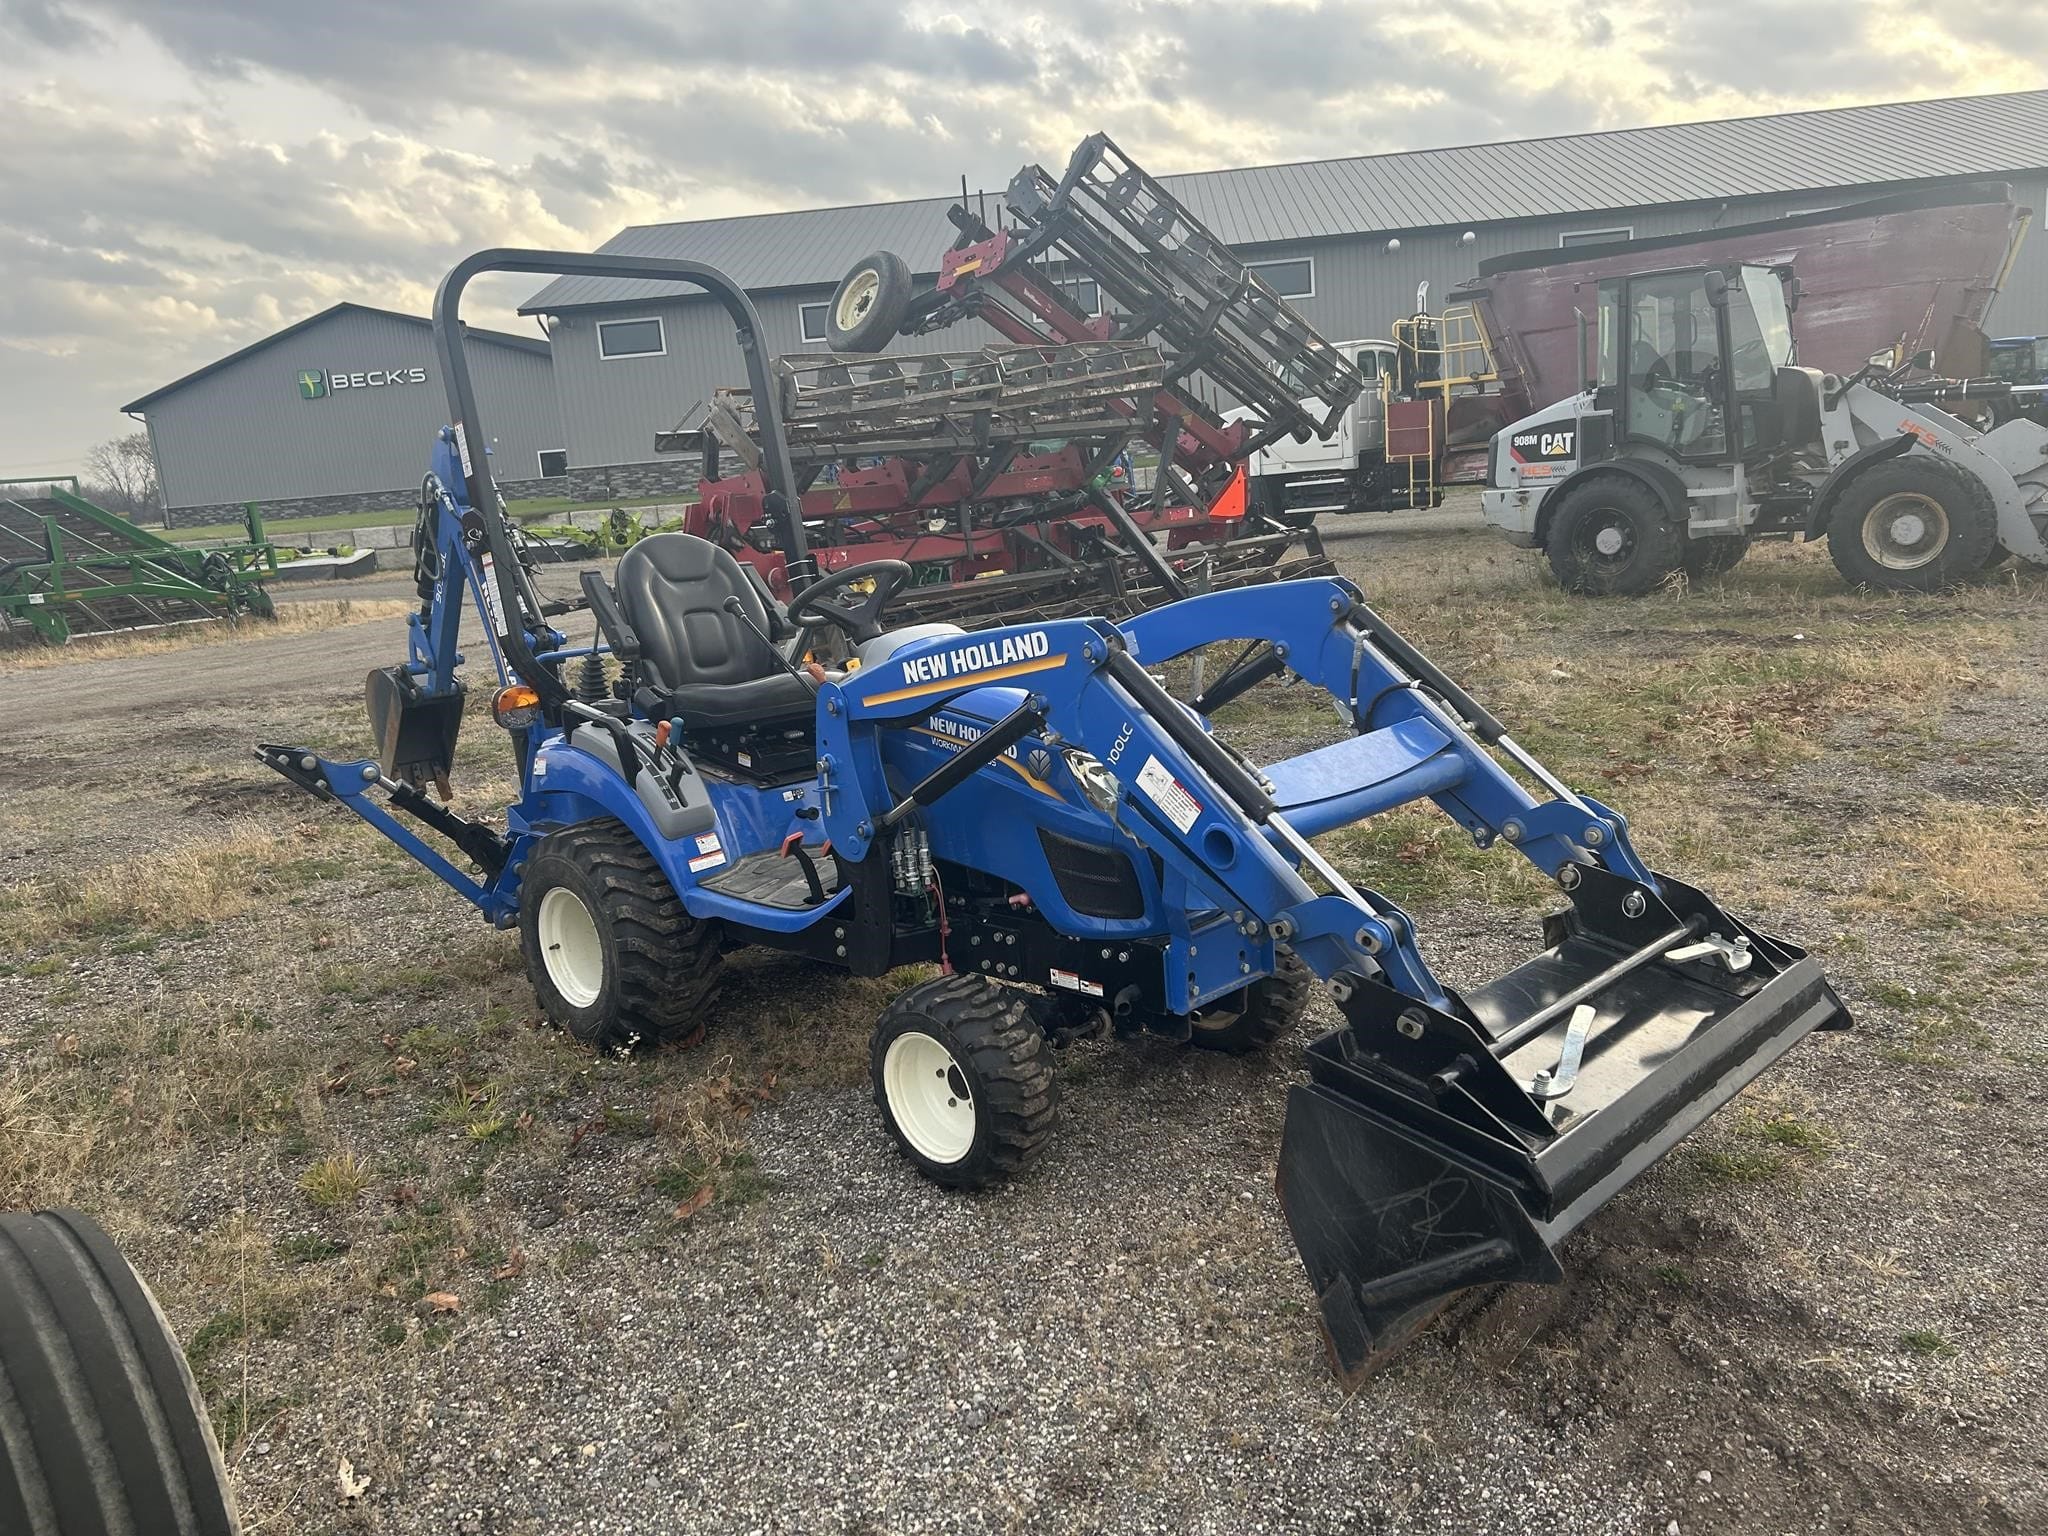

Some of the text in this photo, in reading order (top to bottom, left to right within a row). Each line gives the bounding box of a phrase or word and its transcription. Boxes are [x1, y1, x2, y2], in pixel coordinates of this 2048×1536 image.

[331, 367, 426, 389] BECK'S
[1514, 432, 1575, 455] 908M CAT
[902, 630, 1049, 685] NEW HOLLAND
[929, 716, 957, 736] NEW
[1107, 722, 1134, 765] 100LC
